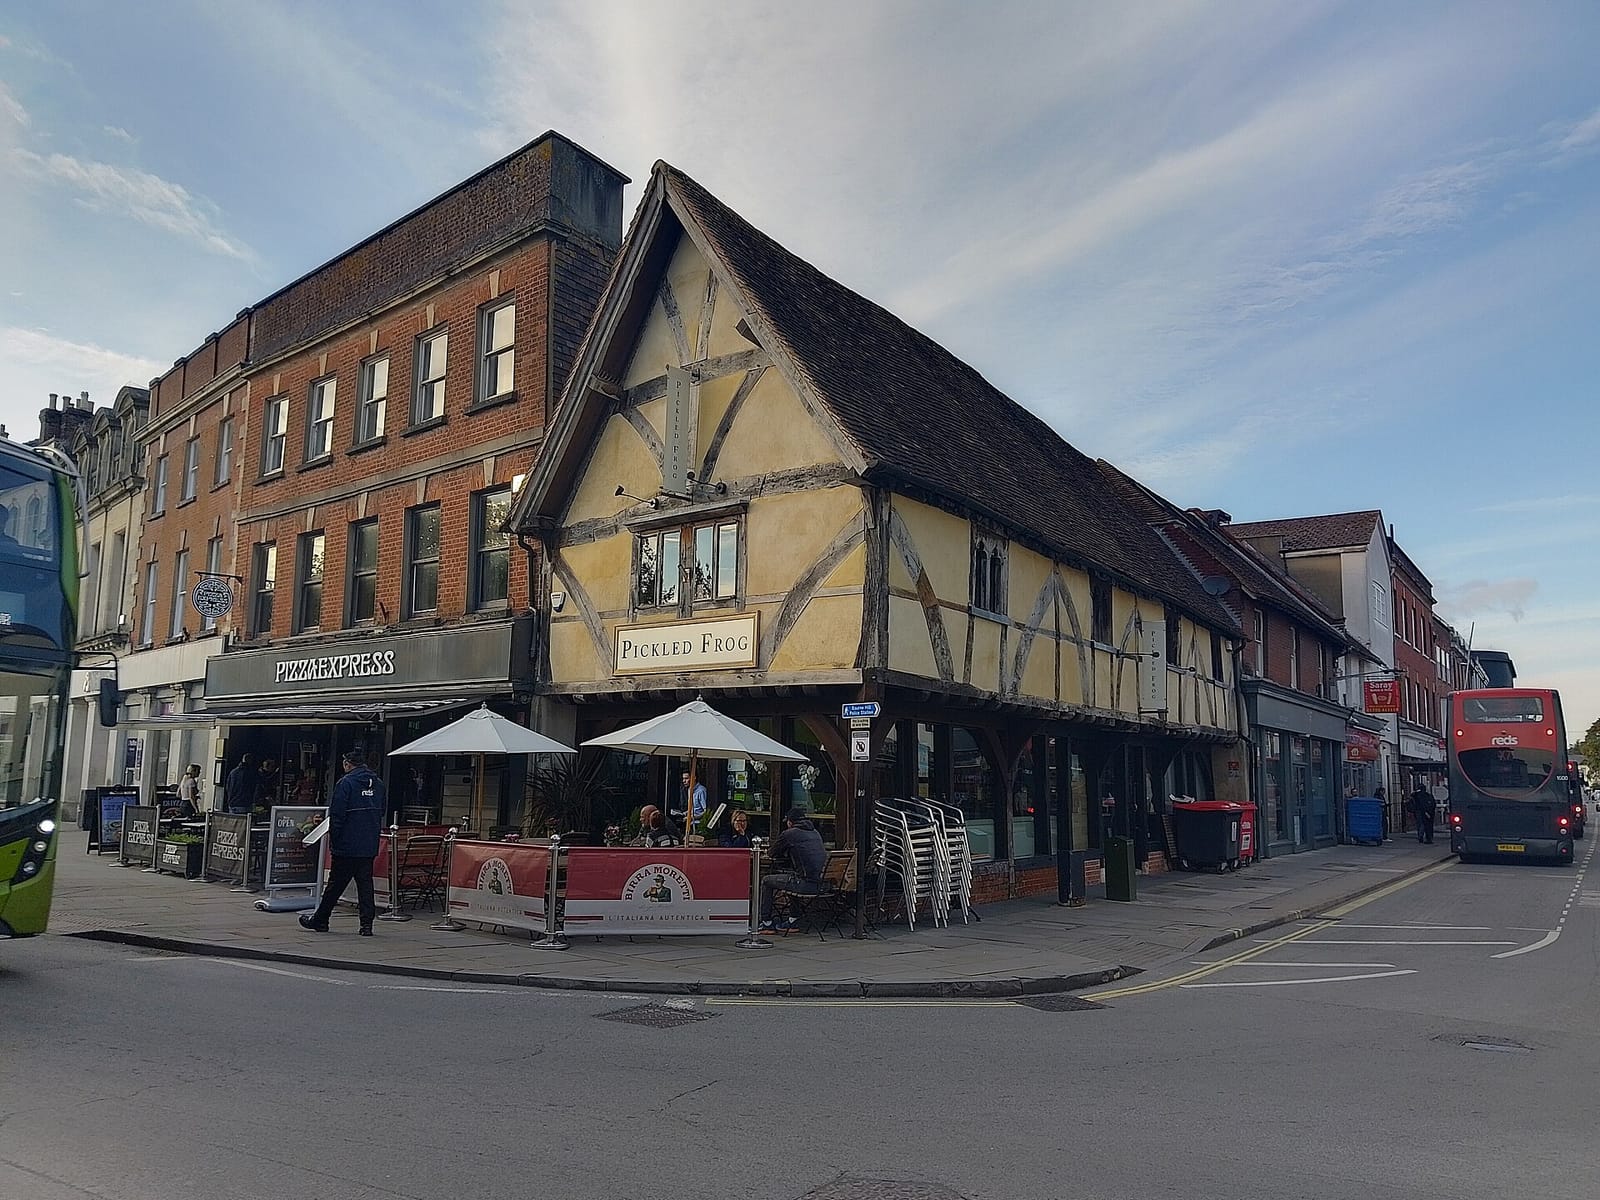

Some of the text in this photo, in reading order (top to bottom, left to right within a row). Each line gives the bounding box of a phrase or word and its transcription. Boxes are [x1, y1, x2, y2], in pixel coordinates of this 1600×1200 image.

[621, 633, 748, 659] PICKLED FROG
[1369, 682, 1393, 690] Saray
[1491, 735, 1518, 745] reds
[277, 819, 295, 828] OPEN
[127, 832, 155, 846] EXPRESS
[217, 830, 238, 846] PIZZA
[624, 866, 691, 901] BIRRA MORETTI
